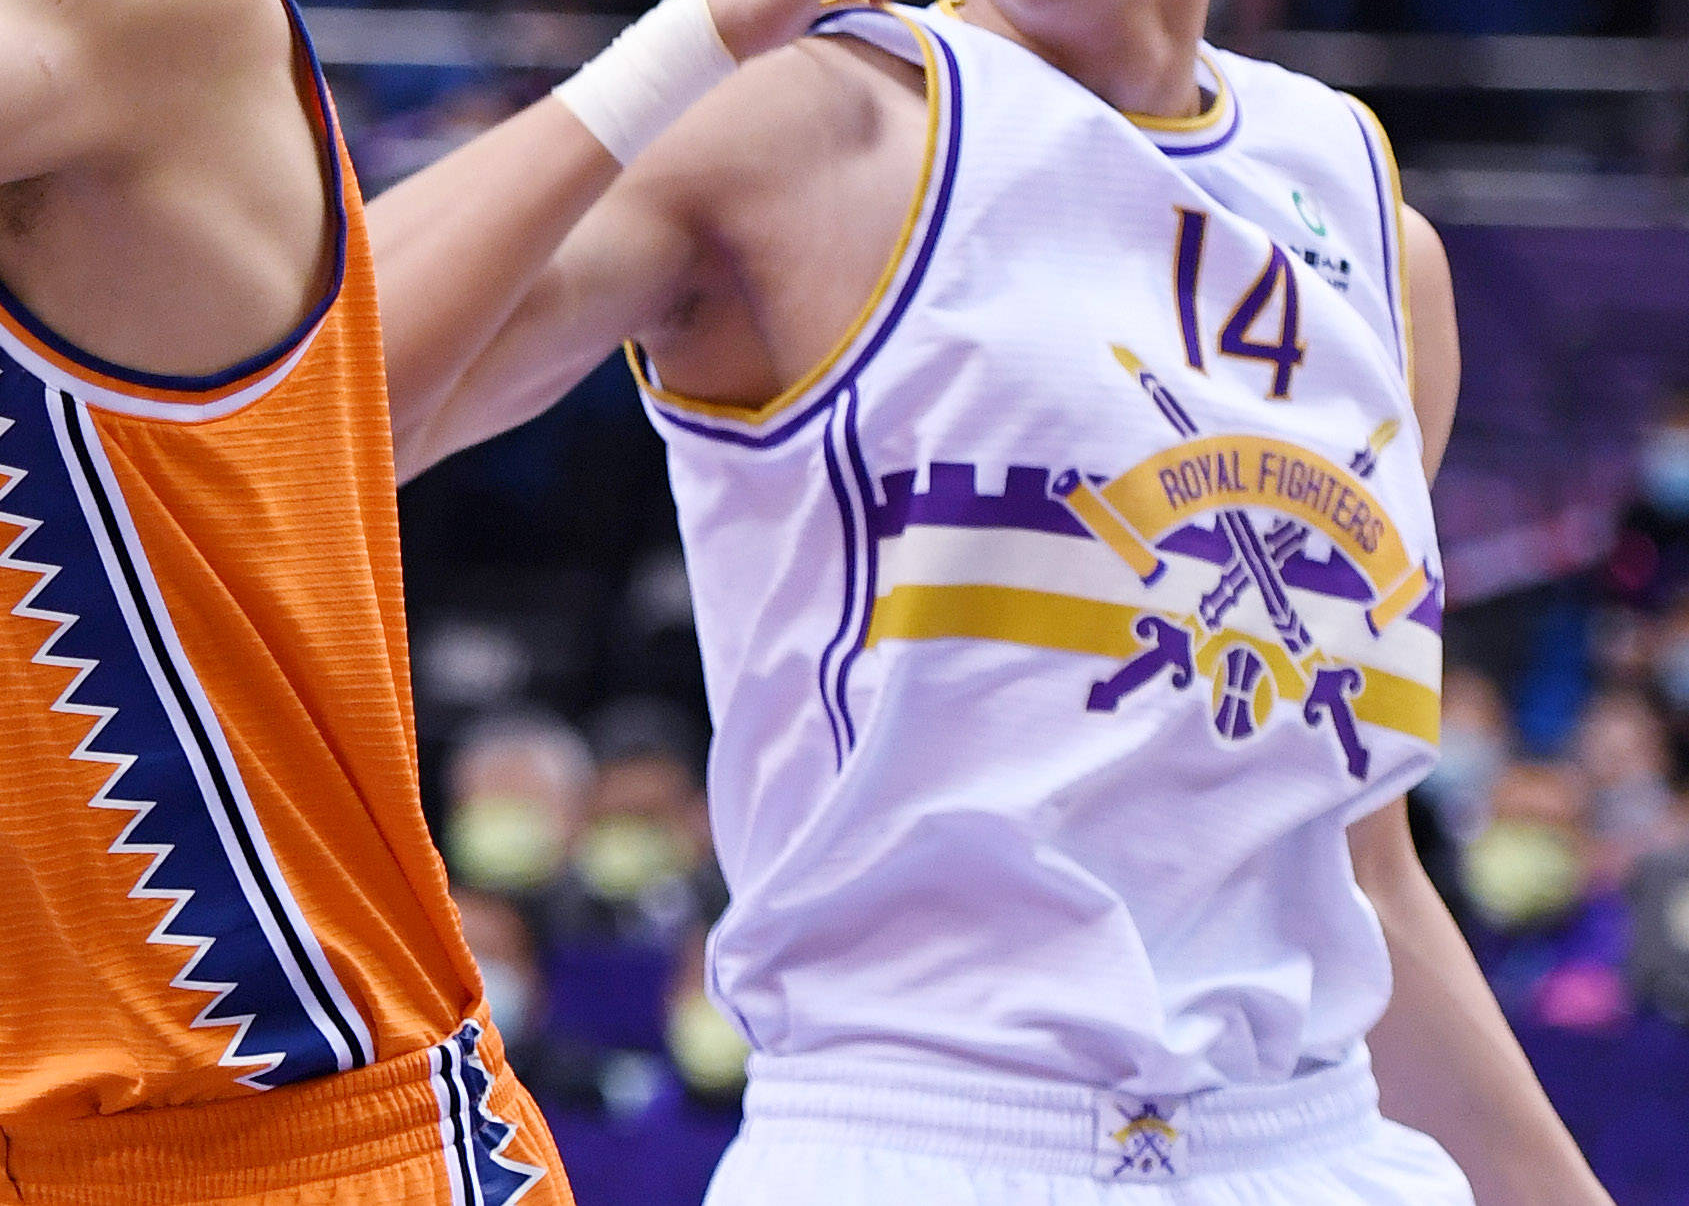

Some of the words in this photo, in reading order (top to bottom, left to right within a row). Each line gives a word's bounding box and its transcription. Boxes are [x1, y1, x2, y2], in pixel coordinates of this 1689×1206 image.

[1173, 202, 1306, 401] 14
[1158, 449, 1249, 512] ROYAL
[1256, 450, 1387, 555] FIGHTERS
